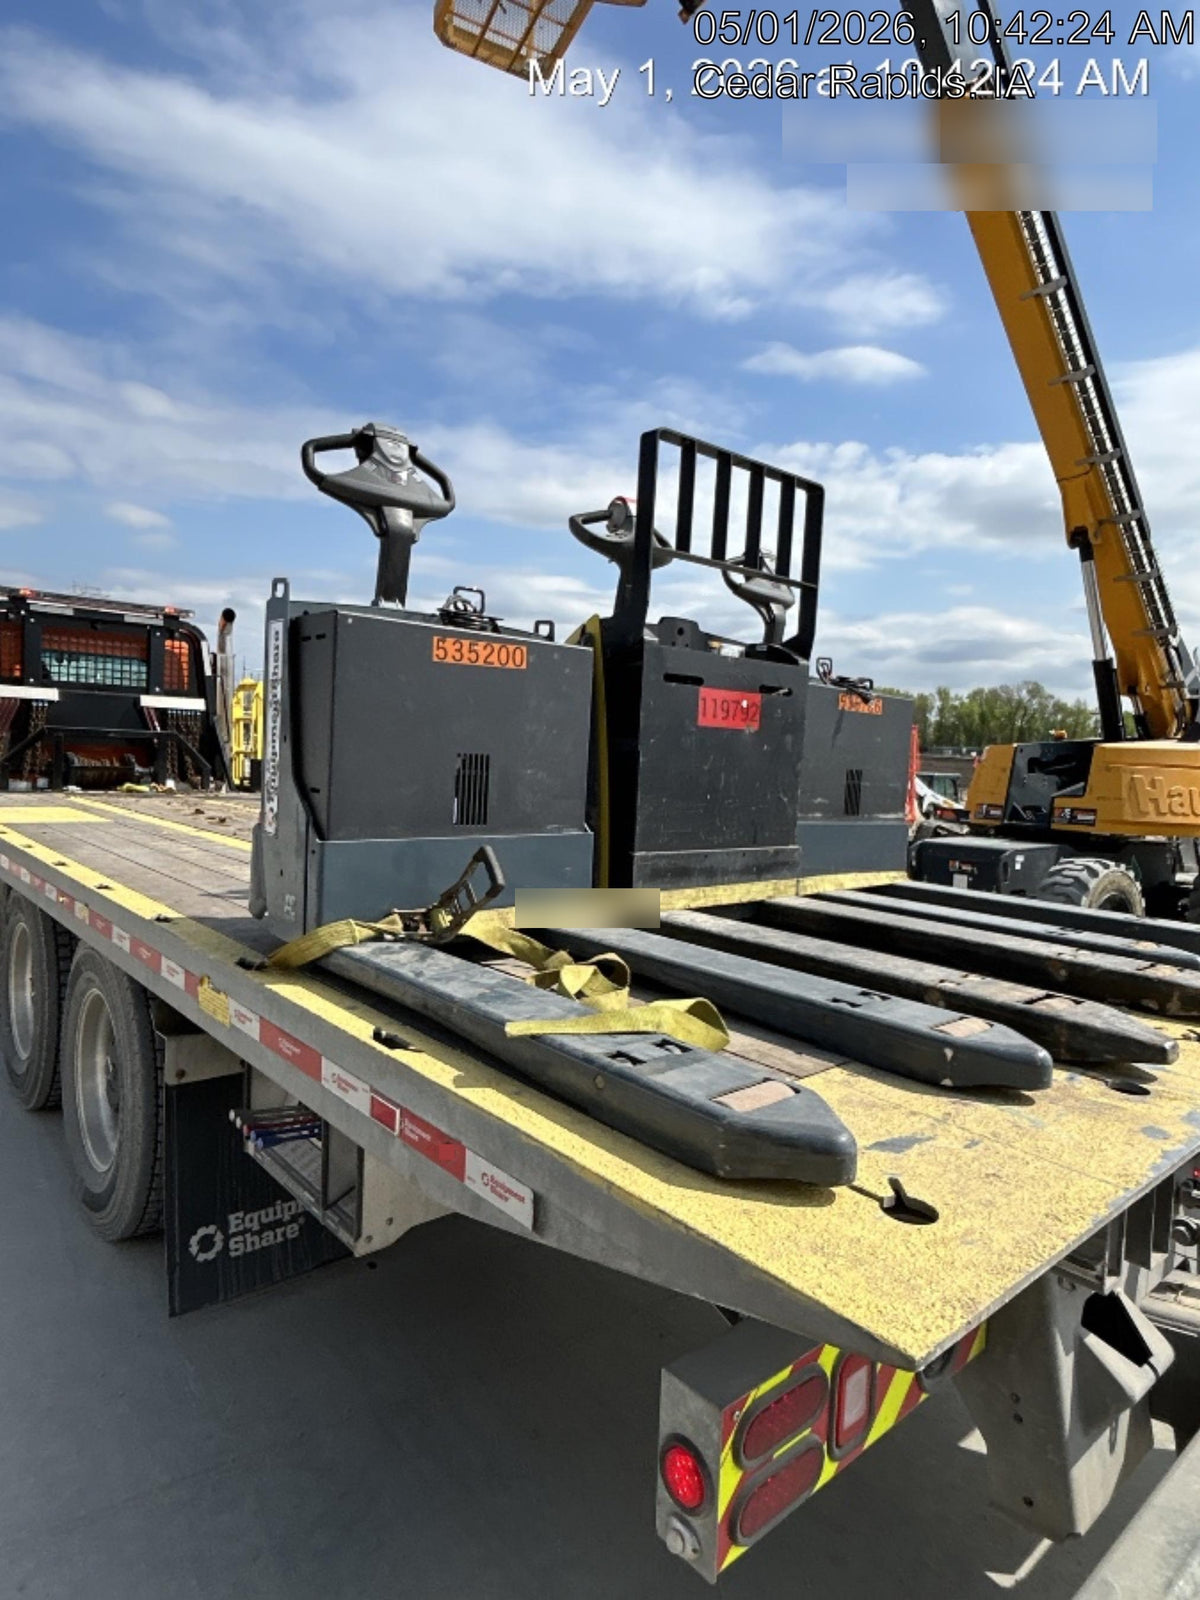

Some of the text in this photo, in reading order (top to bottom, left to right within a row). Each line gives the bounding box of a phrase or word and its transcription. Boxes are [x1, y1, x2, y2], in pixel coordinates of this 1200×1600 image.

[435, 638, 524, 667] 535200
[701, 696, 759, 722] 119792
[228, 1223, 300, 1257] Share
